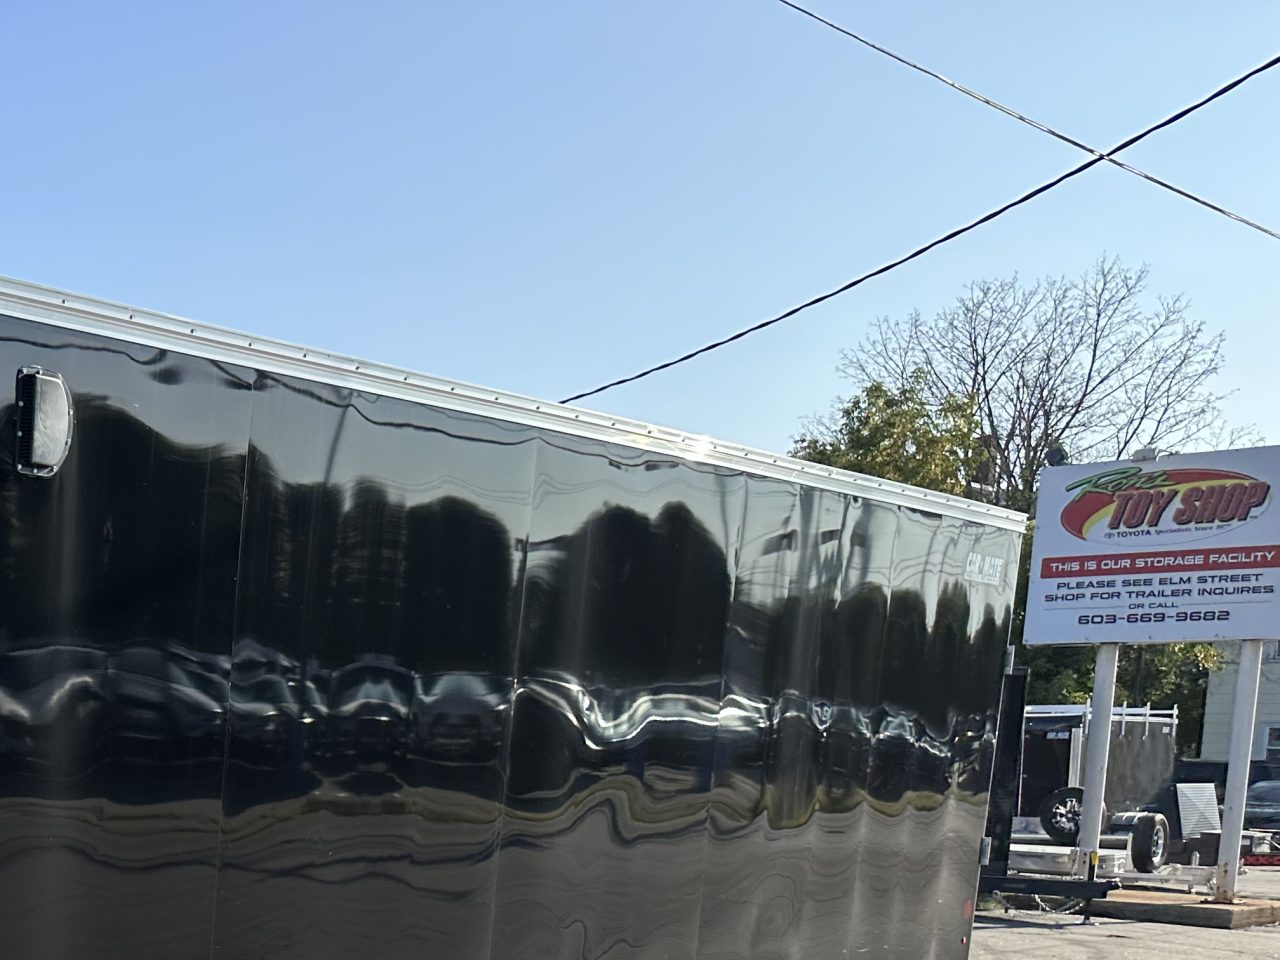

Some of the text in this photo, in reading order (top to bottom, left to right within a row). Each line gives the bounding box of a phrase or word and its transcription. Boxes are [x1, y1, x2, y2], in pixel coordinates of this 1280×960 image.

[1066, 466, 1176, 502] Ron's
[1108, 480, 1271, 530] TOY SHOP
[1116, 529, 1151, 539] TOYOTA
[1050, 551, 1275, 573] THIS IS OUR STORAGE FACILITY
[1056, 573, 1263, 591] PLEASE SEE ELM STREET
[1044, 585, 1274, 603] SHOP FOR TRAILER INQUIRES
[1128, 601, 1179, 610] OR CALL
[1077, 610, 1231, 626] 603-669-9682
